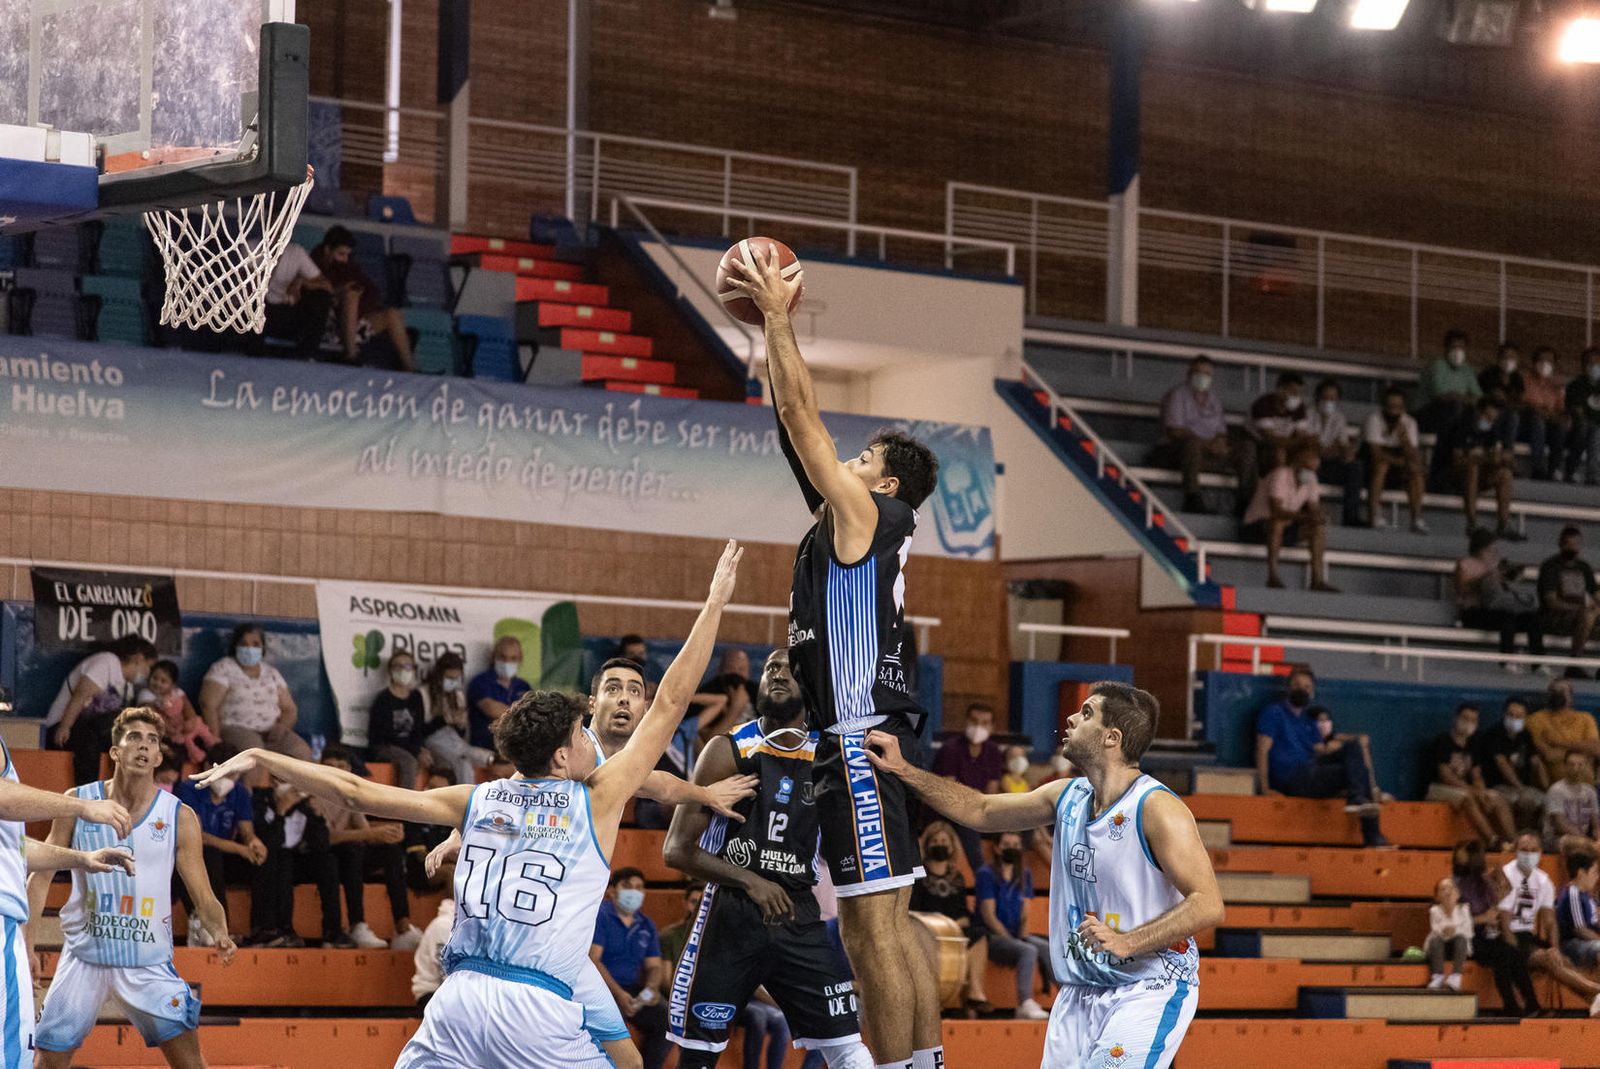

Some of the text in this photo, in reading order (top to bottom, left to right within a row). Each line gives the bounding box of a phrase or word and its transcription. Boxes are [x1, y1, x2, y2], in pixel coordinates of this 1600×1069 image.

[12, 383, 125, 419] Huelva
[202, 369, 263, 411] La
[272, 378, 419, 419] emoción
[432, 383, 468, 438] de
[478, 400, 589, 450] ganar
[599, 399, 673, 453] debe
[678, 417, 721, 449] ser
[358, 435, 398, 474] al
[410, 438, 512, 494] miedo
[521, 446, 554, 500] de
[54, 581, 153, 608] EL GARBANZO
[349, 595, 462, 624] ASPROMIN
[59, 605, 157, 644] DE ORO
[768, 811, 789, 843] 12
[854, 789, 887, 873] HUELVA
[460, 844, 566, 927] 16
[669, 949, 697, 1028] ENRIQUE
[828, 996, 848, 1017] DE
[701, 1005, 731, 1019] Ford
